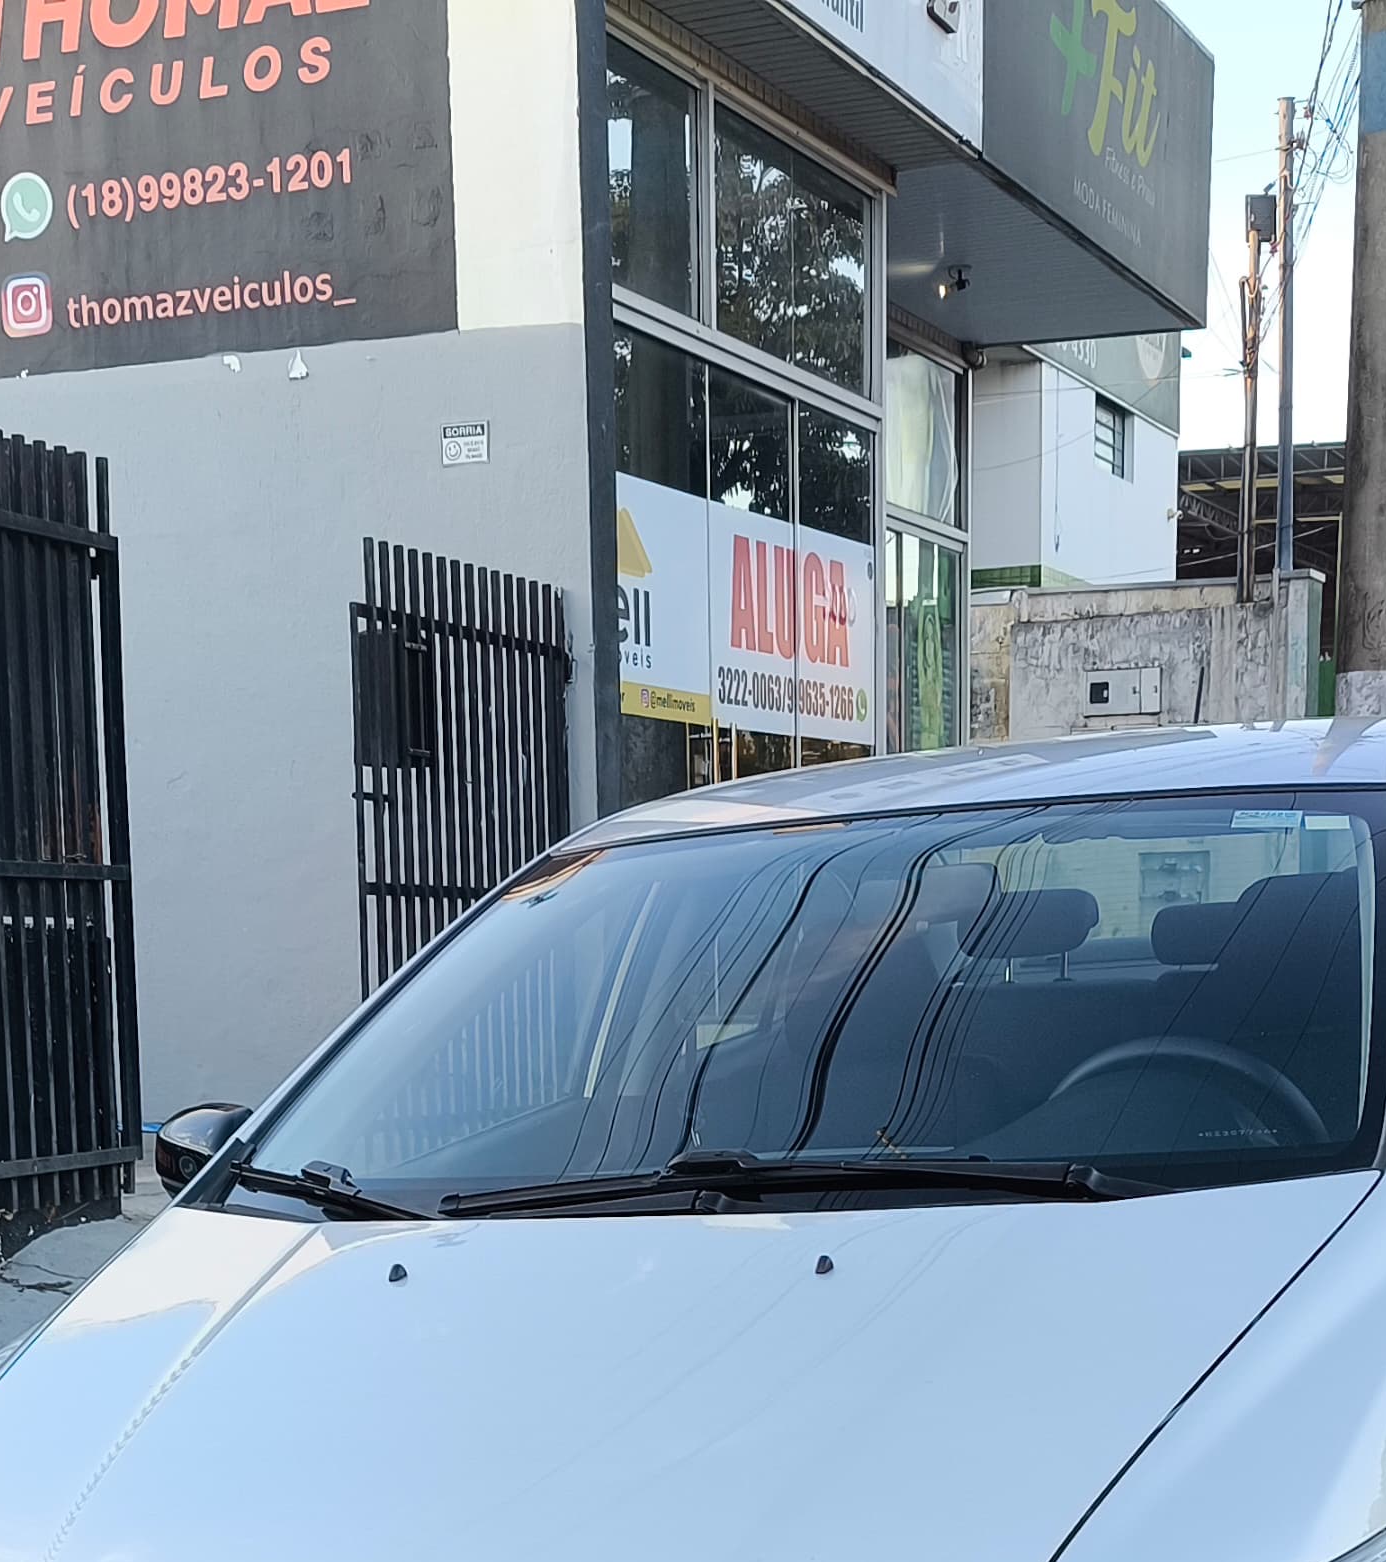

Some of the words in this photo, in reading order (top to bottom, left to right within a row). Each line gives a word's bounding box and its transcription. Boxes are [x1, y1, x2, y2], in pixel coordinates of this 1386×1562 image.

[66, 148, 352, 230] (18)99823-1201
[1073, 175, 1101, 216] MODA
[66, 270, 357, 328] thomazveiculos_
[730, 534, 850, 668] ALUGA
[620, 648, 652, 669] veis
